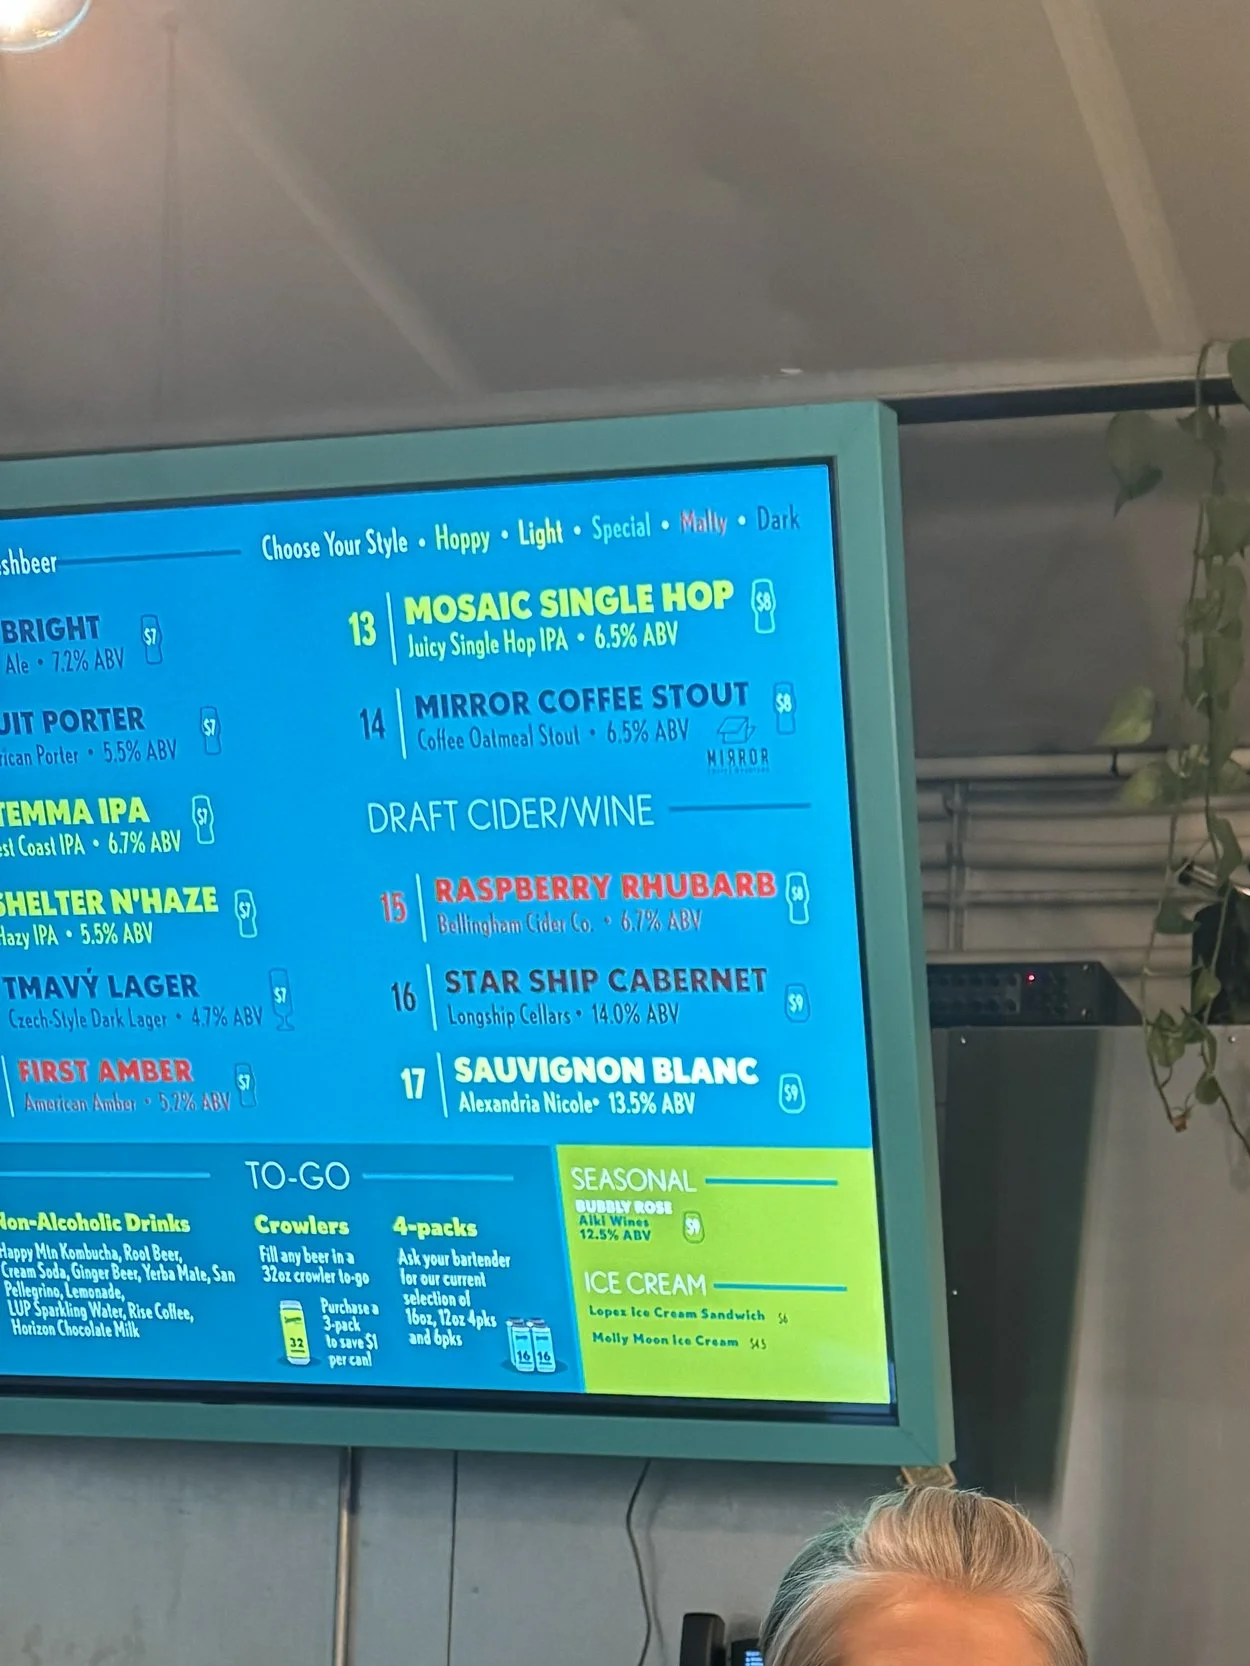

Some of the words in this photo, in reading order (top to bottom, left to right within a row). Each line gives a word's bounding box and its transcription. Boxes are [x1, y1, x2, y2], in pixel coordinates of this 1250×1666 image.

[261, 534, 320, 560] Choose
[323, 530, 361, 557] Your
[366, 526, 408, 559] Style
[435, 523, 490, 555] Hoppy
[518, 517, 563, 550] Light
[592, 512, 651, 544] Special
[757, 504, 800, 531] Dark
[349, 610, 377, 646] 13
[404, 591, 532, 625] MOSAIC
[539, 584, 654, 618] SINGLE
[661, 580, 734, 613] HOP
[0, 615, 100, 644] BRIGHT
[408, 633, 446, 661] Juicy
[450, 630, 499, 659] Single
[503, 628, 536, 657] Hop
[539, 626, 568, 652] IPA
[594, 622, 637, 649] 6.5%
[643, 620, 678, 647] ABV
[5, 652, 29, 675] Ale
[51, 649, 89, 673] 7.2%
[94, 647, 125, 671] ABV
[42, 706, 146, 734] PORTER
[359, 707, 385, 740] 14
[414, 690, 532, 719] MIRROR
[538, 685, 643, 714] COFFEE
[652, 681, 749, 709] STOUT
[417, 727, 464, 751] Coffee
[469, 723, 534, 749] Oatmeal
[538, 722, 580, 746] Stout
[607, 718, 649, 744] 6.5%
[655, 717, 690, 742] ABV
[36, 743, 79, 766] Porter
[103, 739, 141, 764] 5.5%
[147, 738, 177, 761] ABV
[98, 796, 150, 824] IPA
[367, 800, 458, 834] DRAFT
[467, 794, 655, 831] CIDER/WINE
[17, 834, 57, 857] Coast
[59, 833, 85, 856] IPA
[108, 831, 145, 855] 6.7%
[150, 829, 181, 853] ABV
[110, 886, 219, 915] N'HAZE
[381, 892, 407, 923] 15
[434, 874, 611, 903] RASPBERRY
[621, 872, 777, 899] RHUBARB
[32, 923, 59, 946] IPA
[80, 922, 118, 945] 5.5%
[123, 920, 153, 944] ABV
[437, 912, 522, 937] Bellingham
[667, 909, 701, 932] ABV
[2, 967, 99, 1000] TMAVÝ
[107, 973, 200, 999] LAGER
[391, 981, 417, 1012] 16
[445, 969, 521, 994] STAR
[529, 968, 599, 994] SHIP
[608, 967, 768, 993] CABERNET
[9, 1007, 87, 1032] Czech-Style
[91, 1007, 125, 1029] Dark
[129, 1008, 167, 1031] Lager
[191, 1006, 228, 1028] 4.7%
[233, 1005, 263, 1027] ABV
[448, 1002, 515, 1029] Longship
[520, 1003, 571, 1025] Cellars
[592, 1002, 641, 1025] 14.0%
[647, 1003, 680, 1025] ABV
[18, 1059, 89, 1084] FIRST
[98, 1058, 195, 1084] AMBER
[400, 1067, 426, 1100] 17
[453, 1056, 646, 1084] SAUVIGNON
[652, 1056, 759, 1085] BLANC
[201, 1091, 232, 1112] ABV
[458, 1090, 540, 1114] Alexandria
[608, 1091, 657, 1115] 13.5%
[661, 1092, 695, 1115] ABV
[245, 1160, 350, 1190] TO-GO
[571, 1166, 697, 1193] SEASONAL
[124, 1212, 191, 1233] Drinks
[254, 1213, 350, 1235] Crowlers
[393, 1215, 478, 1240] 4-packs
[0, 1241, 33, 1263] Happy
[59, 1242, 123, 1263] Kombucha,
[151, 1243, 183, 1264] Beer,
[258, 1244, 278, 1263] Fill
[281, 1250, 301, 1267] any
[301, 1245, 329, 1265] beer
[398, 1247, 421, 1266] Ask
[423, 1253, 450, 1269] your
[450, 1248, 511, 1268] bartender
[0, 1261, 36, 1279] Cream
[37, 1261, 70, 1281] Soda,
[71, 1262, 109, 1283] Ginger
[111, 1262, 142, 1283] Beer,
[213, 1264, 236, 1283] San
[294, 1266, 338, 1285] crowler
[420, 1273, 441, 1286] our
[584, 1271, 622, 1294] ICE
[626, 1272, 707, 1297] CREAM
[64, 1281, 126, 1302] Lemonade,
[403, 1288, 457, 1307] selection
[6, 1299, 31, 1317] LUP
[33, 1299, 88, 1321] Sparkling
[127, 1301, 152, 1319] Rise
[320, 1296, 369, 1315] Purchase
[589, 1305, 627, 1319] Lopez
[631, 1306, 650, 1318] Ice
[654, 1307, 697, 1320] Cream
[701, 1308, 765, 1321] Sandwich
[10, 1318, 56, 1336] Horizon
[113, 1320, 141, 1338] Milk
[322, 1314, 361, 1334] 3-pack
[408, 1328, 431, 1346] and
[339, 1337, 364, 1350] save
[592, 1332, 628, 1346] Molly
[633, 1333, 669, 1345] Moon
[695, 1335, 739, 1347] Cream
